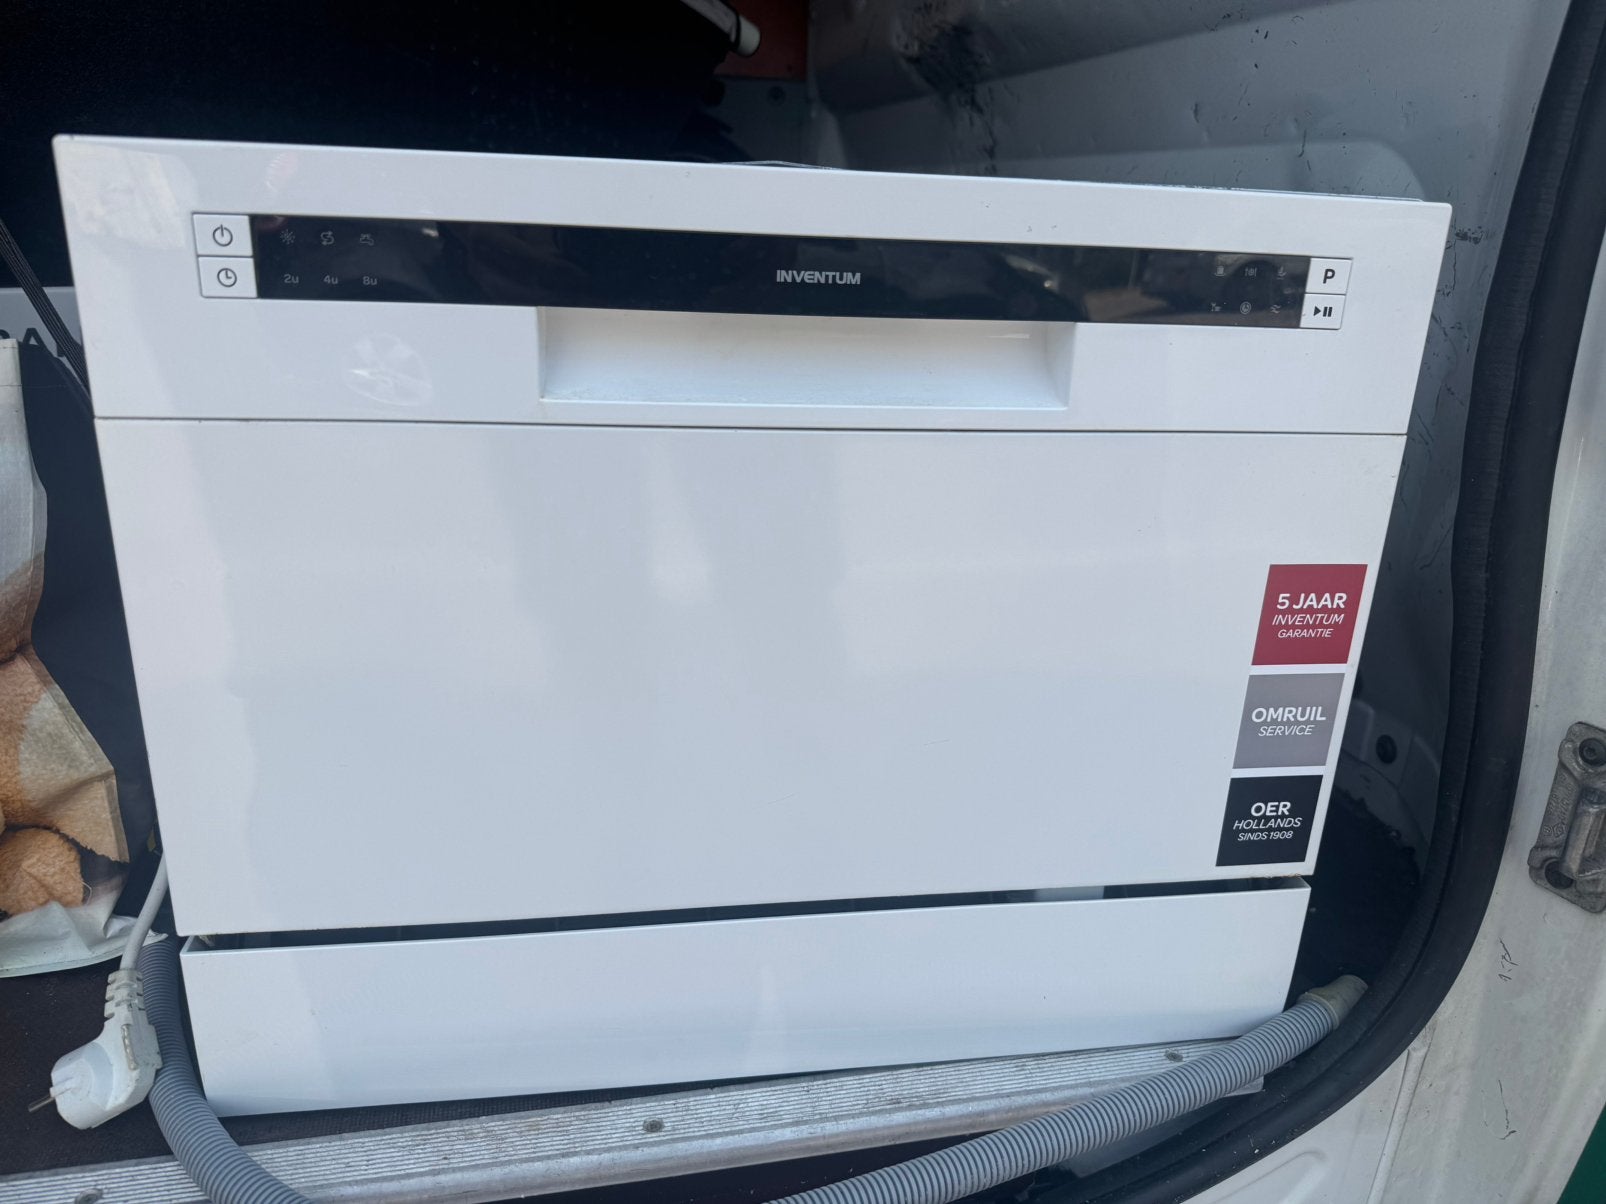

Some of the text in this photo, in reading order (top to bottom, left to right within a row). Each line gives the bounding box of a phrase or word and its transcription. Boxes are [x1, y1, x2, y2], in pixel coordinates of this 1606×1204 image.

[283, 274, 299, 283] 2u
[323, 275, 338, 284] 4u
[362, 276, 378, 285] 8u
[776, 269, 861, 285] INVENTUM
[1322, 268, 1336, 284] P
[1276, 592, 1348, 610] 5 JAAR
[1272, 613, 1344, 625] INVENTUM
[1277, 628, 1334, 639] GARANTIE
[1251, 706, 1327, 723] OMRUIL
[1258, 724, 1315, 737] SERVICE
[1250, 801, 1292, 817] OER
[1233, 817, 1303, 830] HOLLANDS
[1237, 830, 1293, 841] SINDS 1908
